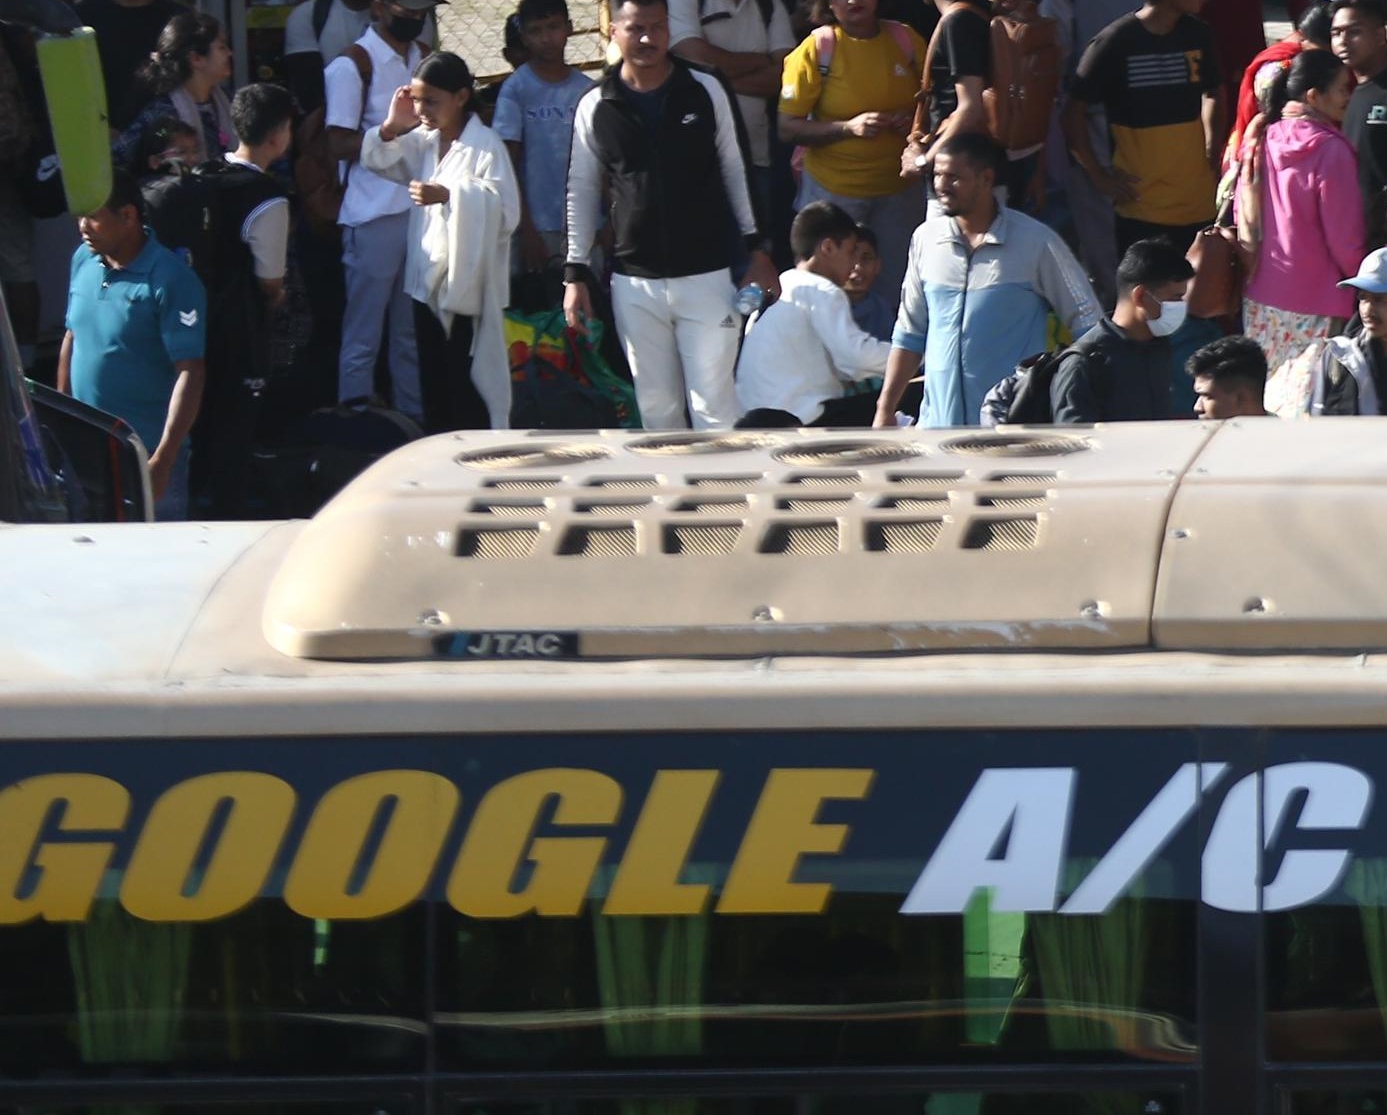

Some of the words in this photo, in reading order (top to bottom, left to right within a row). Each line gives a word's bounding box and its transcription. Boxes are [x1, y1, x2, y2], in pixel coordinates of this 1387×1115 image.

[466, 631, 565, 657] JTAC
[0, 767, 875, 924] GOOGLE
[899, 760, 1374, 915] A/C
